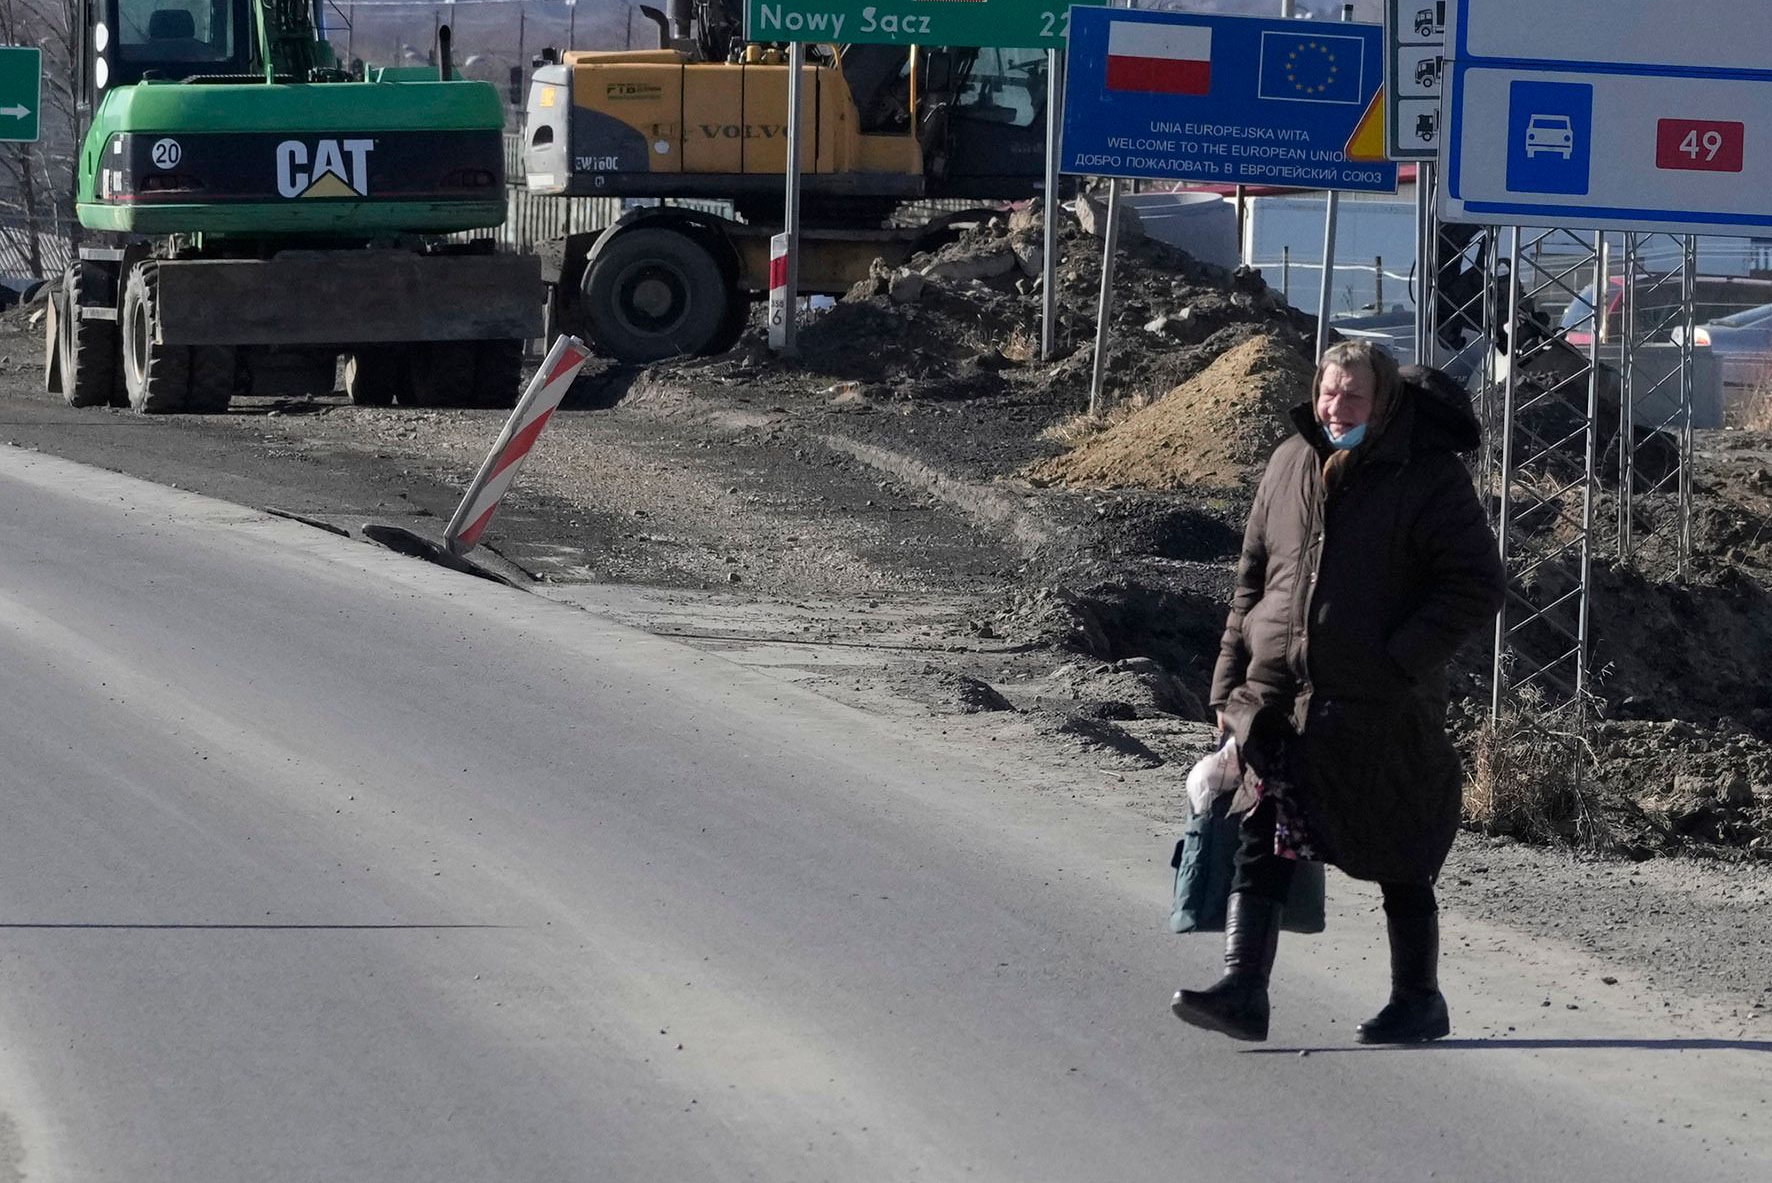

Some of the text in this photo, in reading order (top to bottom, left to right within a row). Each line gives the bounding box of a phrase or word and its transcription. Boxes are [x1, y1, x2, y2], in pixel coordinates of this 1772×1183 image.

[759, 3, 846, 39] Nowy
[859, 6, 932, 40] Sącz
[1150, 121, 1310, 141] UNIA EUROPEJSKA WITA
[156, 143, 180, 164] 20
[1107, 137, 1176, 152] WELCOME
[1180, 141, 1198, 153] TO
[1202, 143, 1228, 155] THE
[1231, 144, 1306, 160] EUROPEAN
[1677, 129, 1724, 162] 49
[276, 139, 375, 198] CAT
[1075, 153, 1382, 184] ДОБРО ПОЖАЛОВАТЬ В ЕВРОПЕЙСКИЙ СОЮЗ
[772, 309, 782, 325] 6
